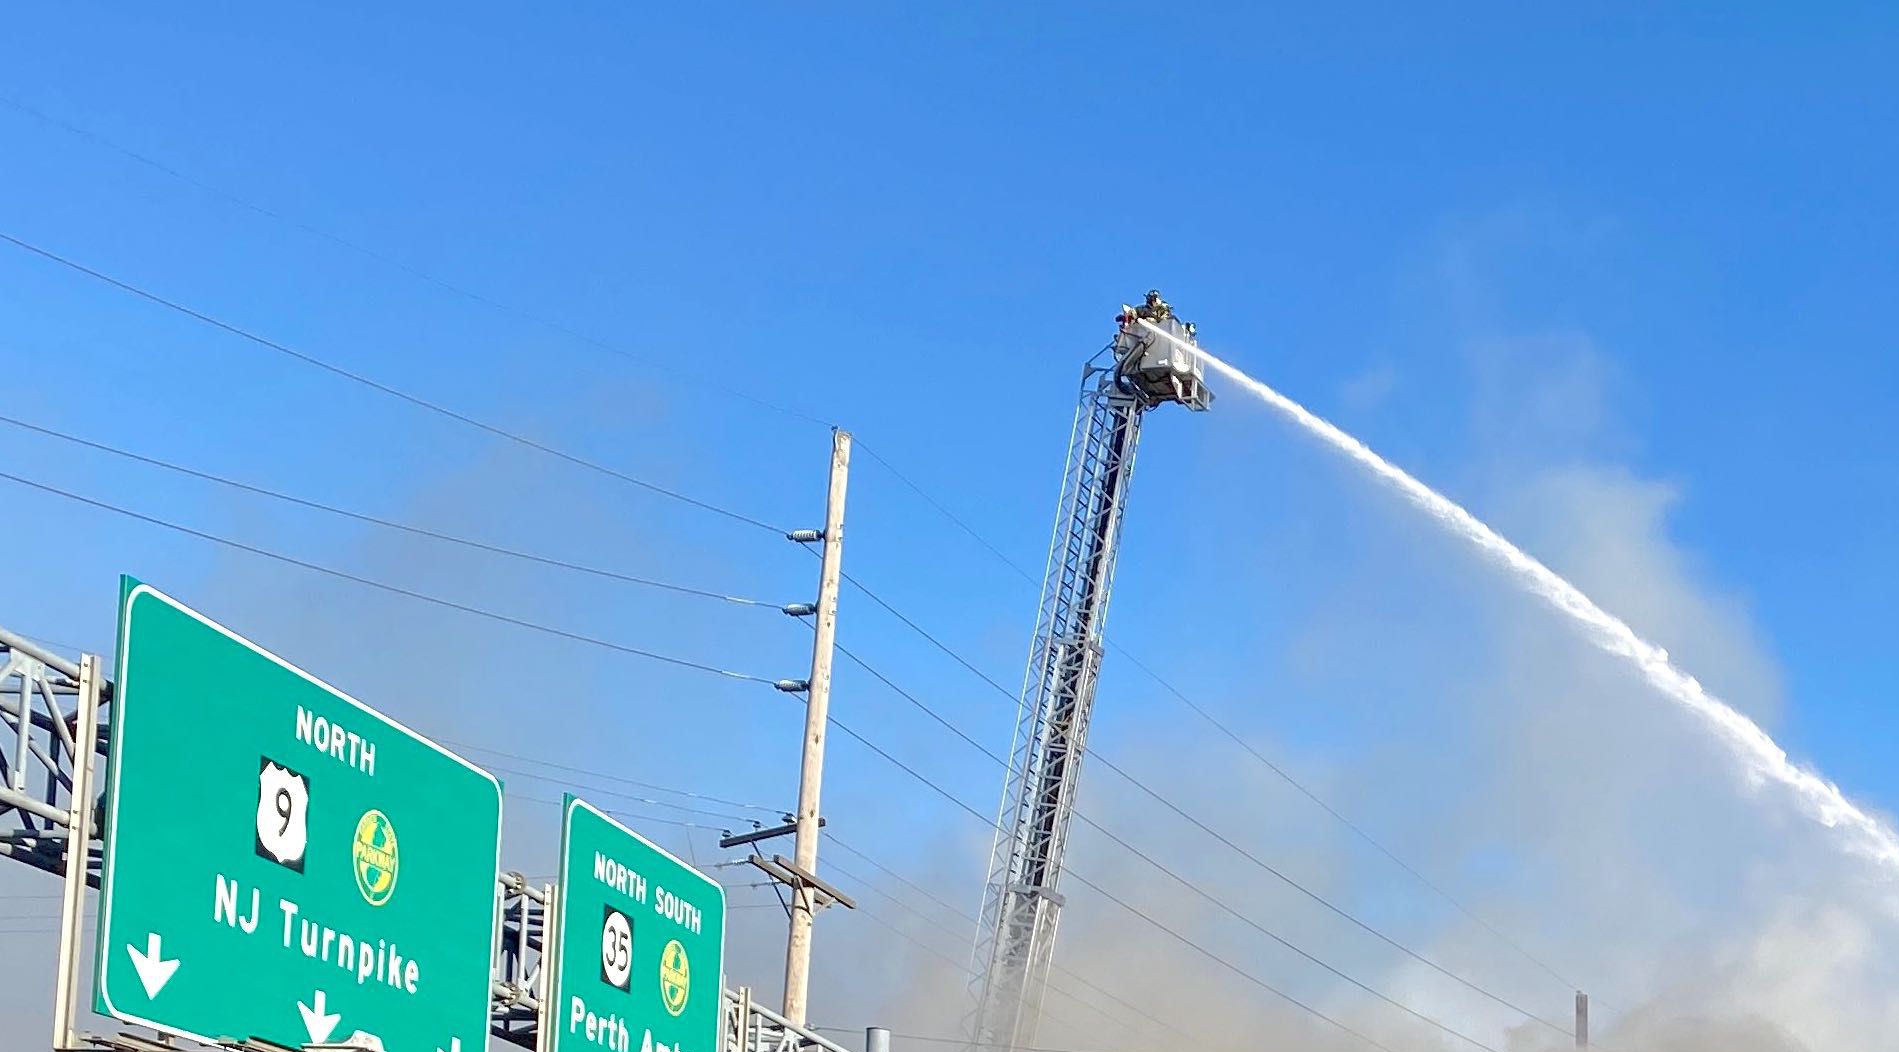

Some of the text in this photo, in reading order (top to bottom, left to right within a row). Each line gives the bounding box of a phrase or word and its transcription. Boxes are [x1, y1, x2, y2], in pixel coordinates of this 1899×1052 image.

[295, 704, 377, 777] NORTH
[276, 787, 293, 838] 9
[593, 850, 702, 935] NORTH SOUTH
[213, 872, 420, 995] NJ Turnpike
[607, 925, 629, 972] 35
